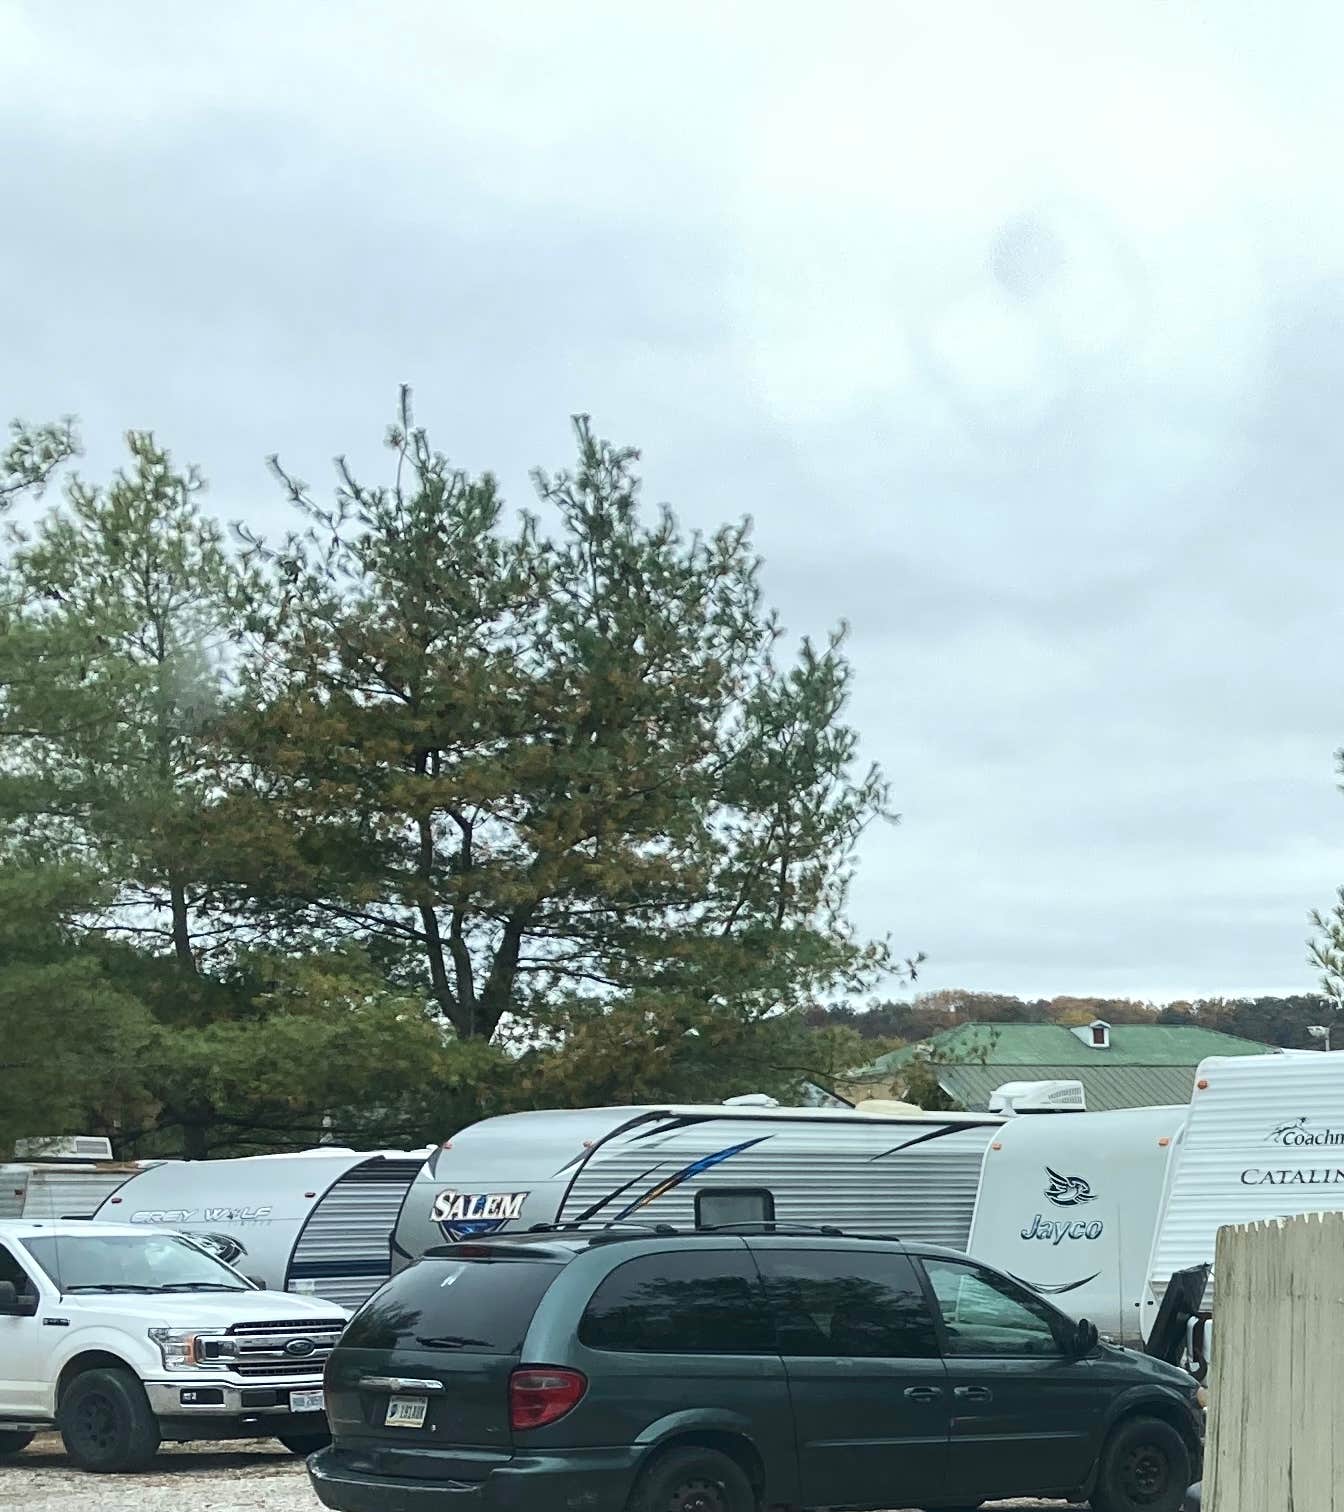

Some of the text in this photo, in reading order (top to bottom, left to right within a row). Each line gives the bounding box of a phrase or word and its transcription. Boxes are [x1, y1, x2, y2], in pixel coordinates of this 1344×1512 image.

[130, 1208, 200, 1224] GREY
[430, 1189, 528, 1221] SALEM
[1020, 1214, 1104, 1246] Jayco
